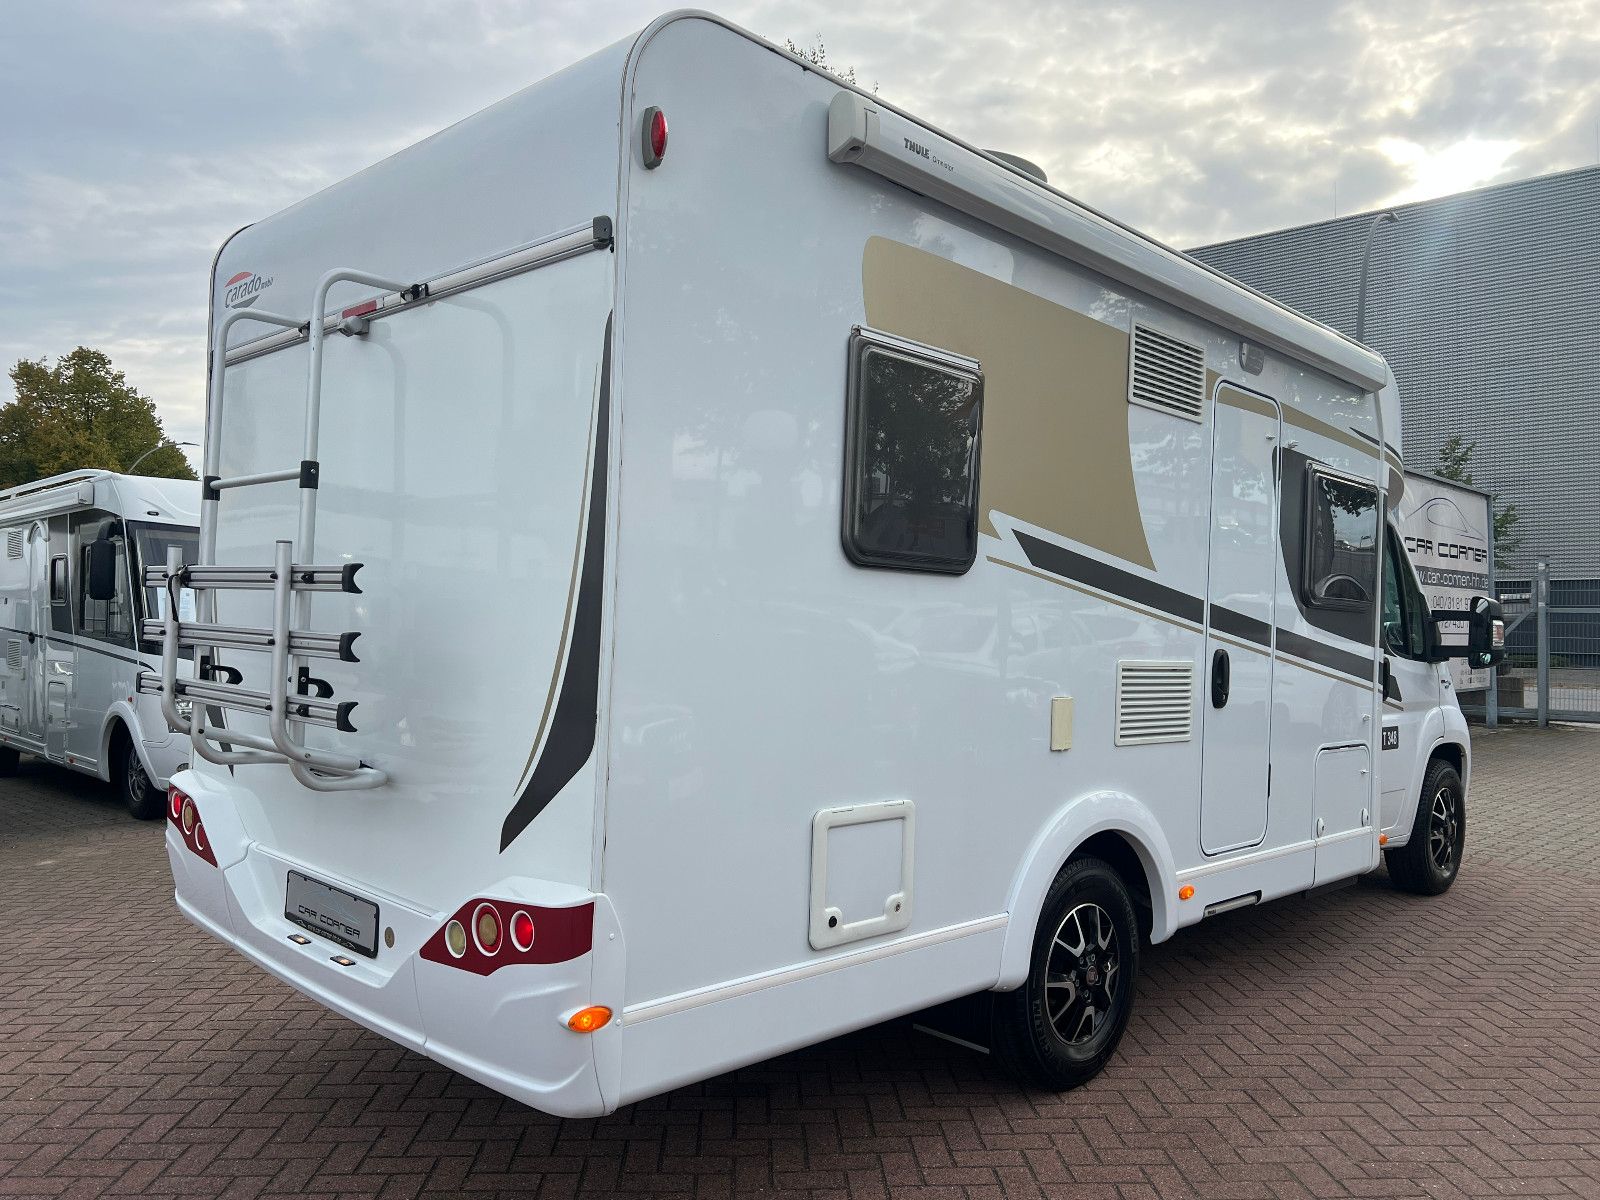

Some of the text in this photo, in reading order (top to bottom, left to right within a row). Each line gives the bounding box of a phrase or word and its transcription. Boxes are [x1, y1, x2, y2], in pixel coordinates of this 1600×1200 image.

[903, 137, 930, 160] THULE
[225, 273, 262, 309] carado
[1404, 536, 1488, 564] CAR CORNER
[1383, 731, 1387, 745] T
[298, 905, 318, 920] CAR
[320, 914, 361, 940] CORNER
